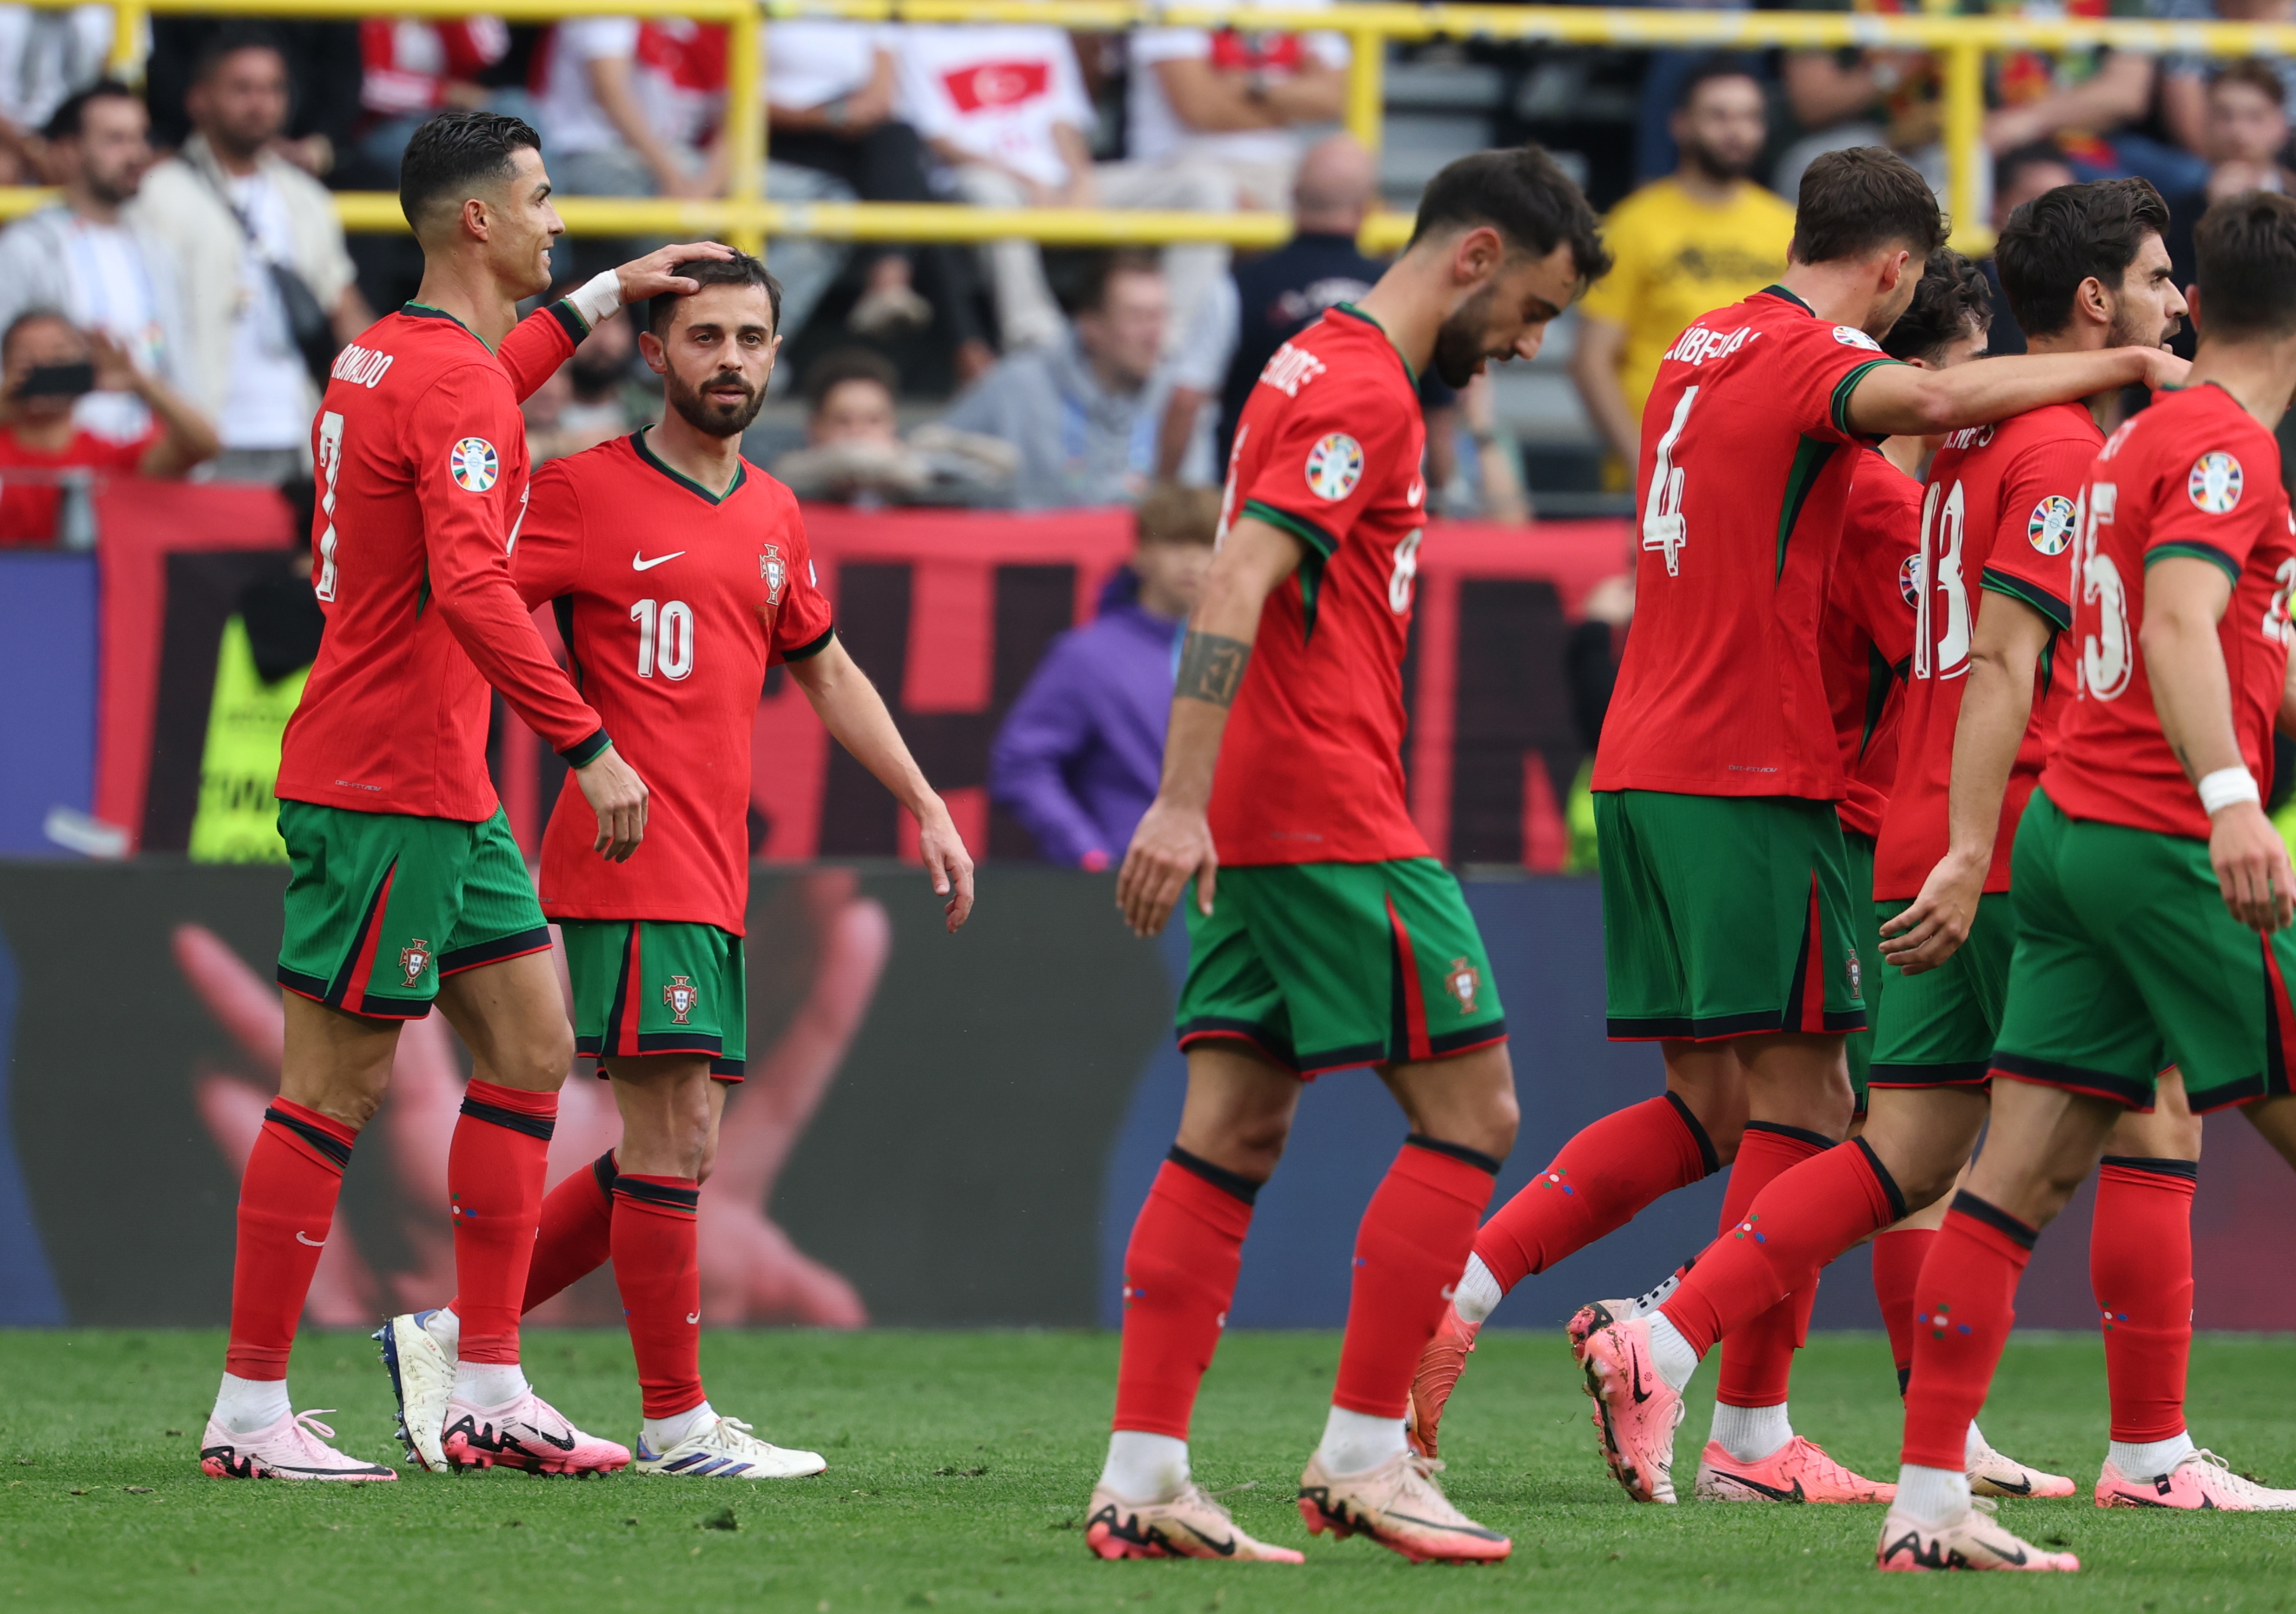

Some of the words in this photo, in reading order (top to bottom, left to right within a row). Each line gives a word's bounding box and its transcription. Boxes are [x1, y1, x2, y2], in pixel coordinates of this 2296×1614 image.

[331, 343, 394, 389] RONALDO
[314, 410, 344, 603] 7
[1642, 385, 1700, 577] 4
[630, 598, 694, 682] 10
[423, 1337, 436, 1351] COPA
